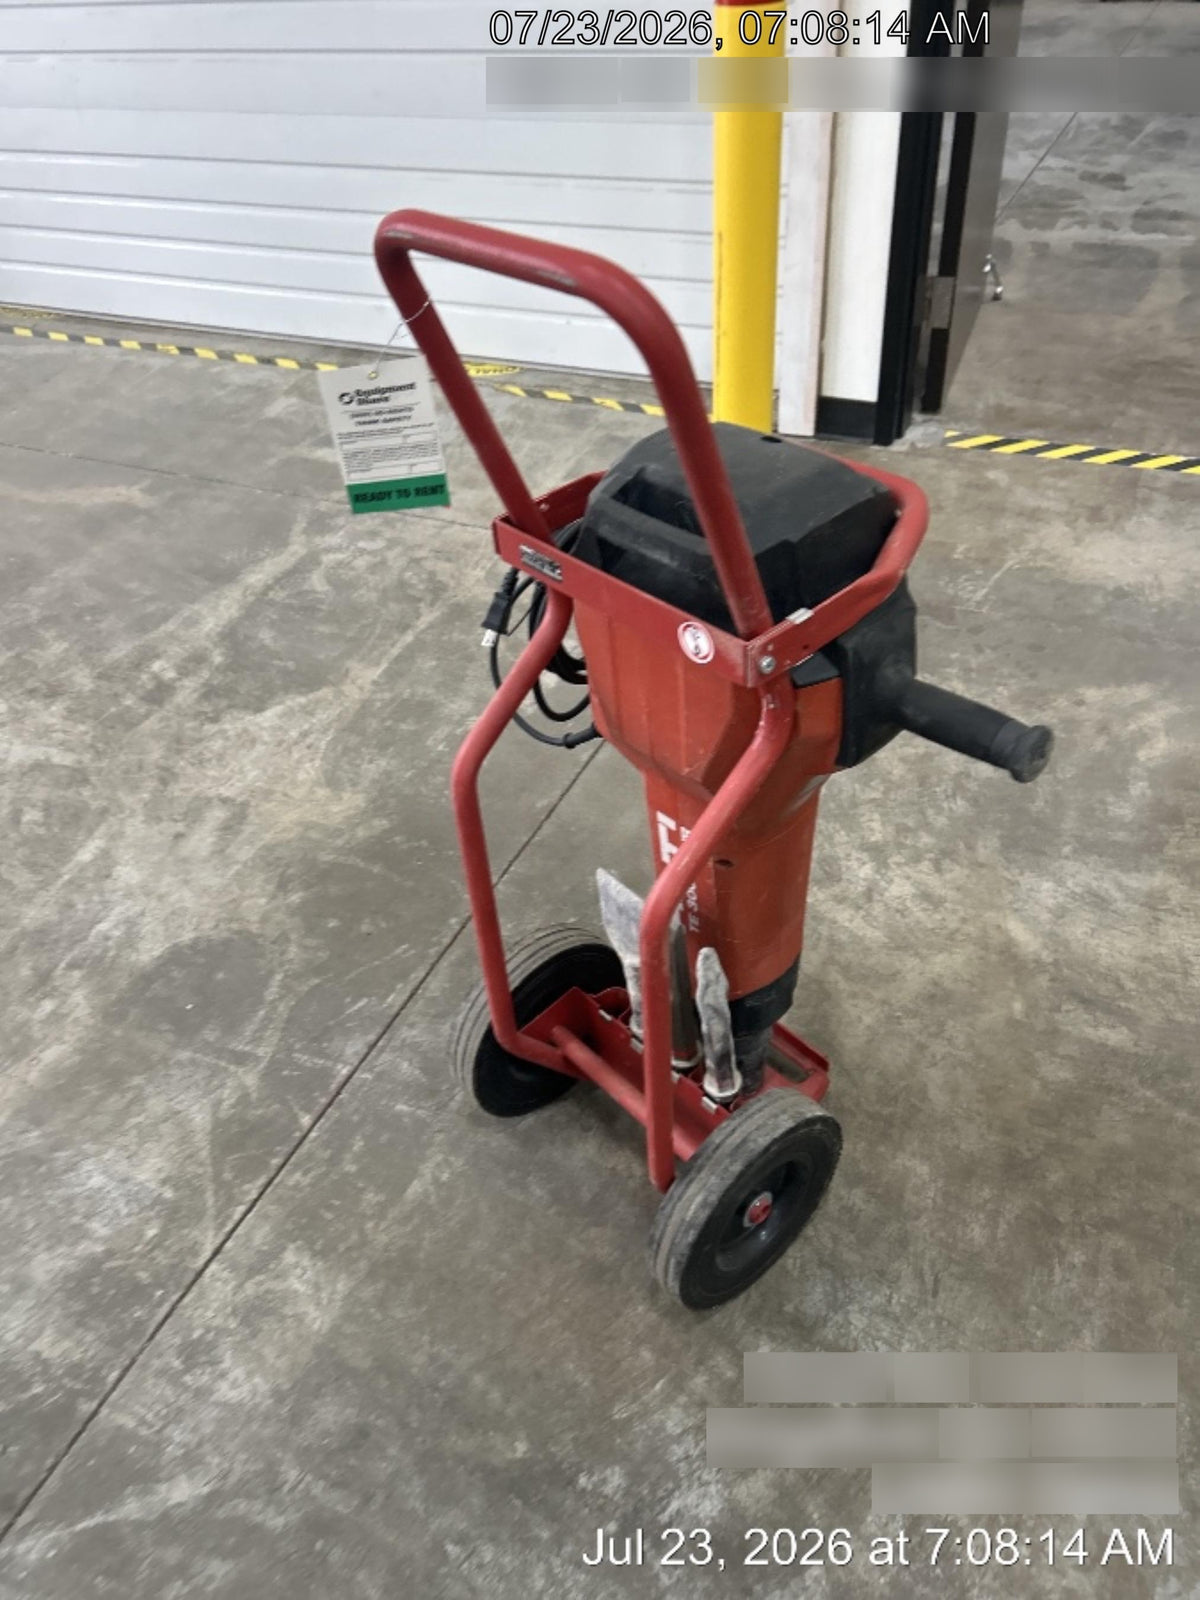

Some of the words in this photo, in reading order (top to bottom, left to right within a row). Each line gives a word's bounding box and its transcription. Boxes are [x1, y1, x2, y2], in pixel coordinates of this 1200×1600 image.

[354, 490, 392, 503] READY
[395, 488, 411, 499] TO
[414, 484, 445, 497] RENT
